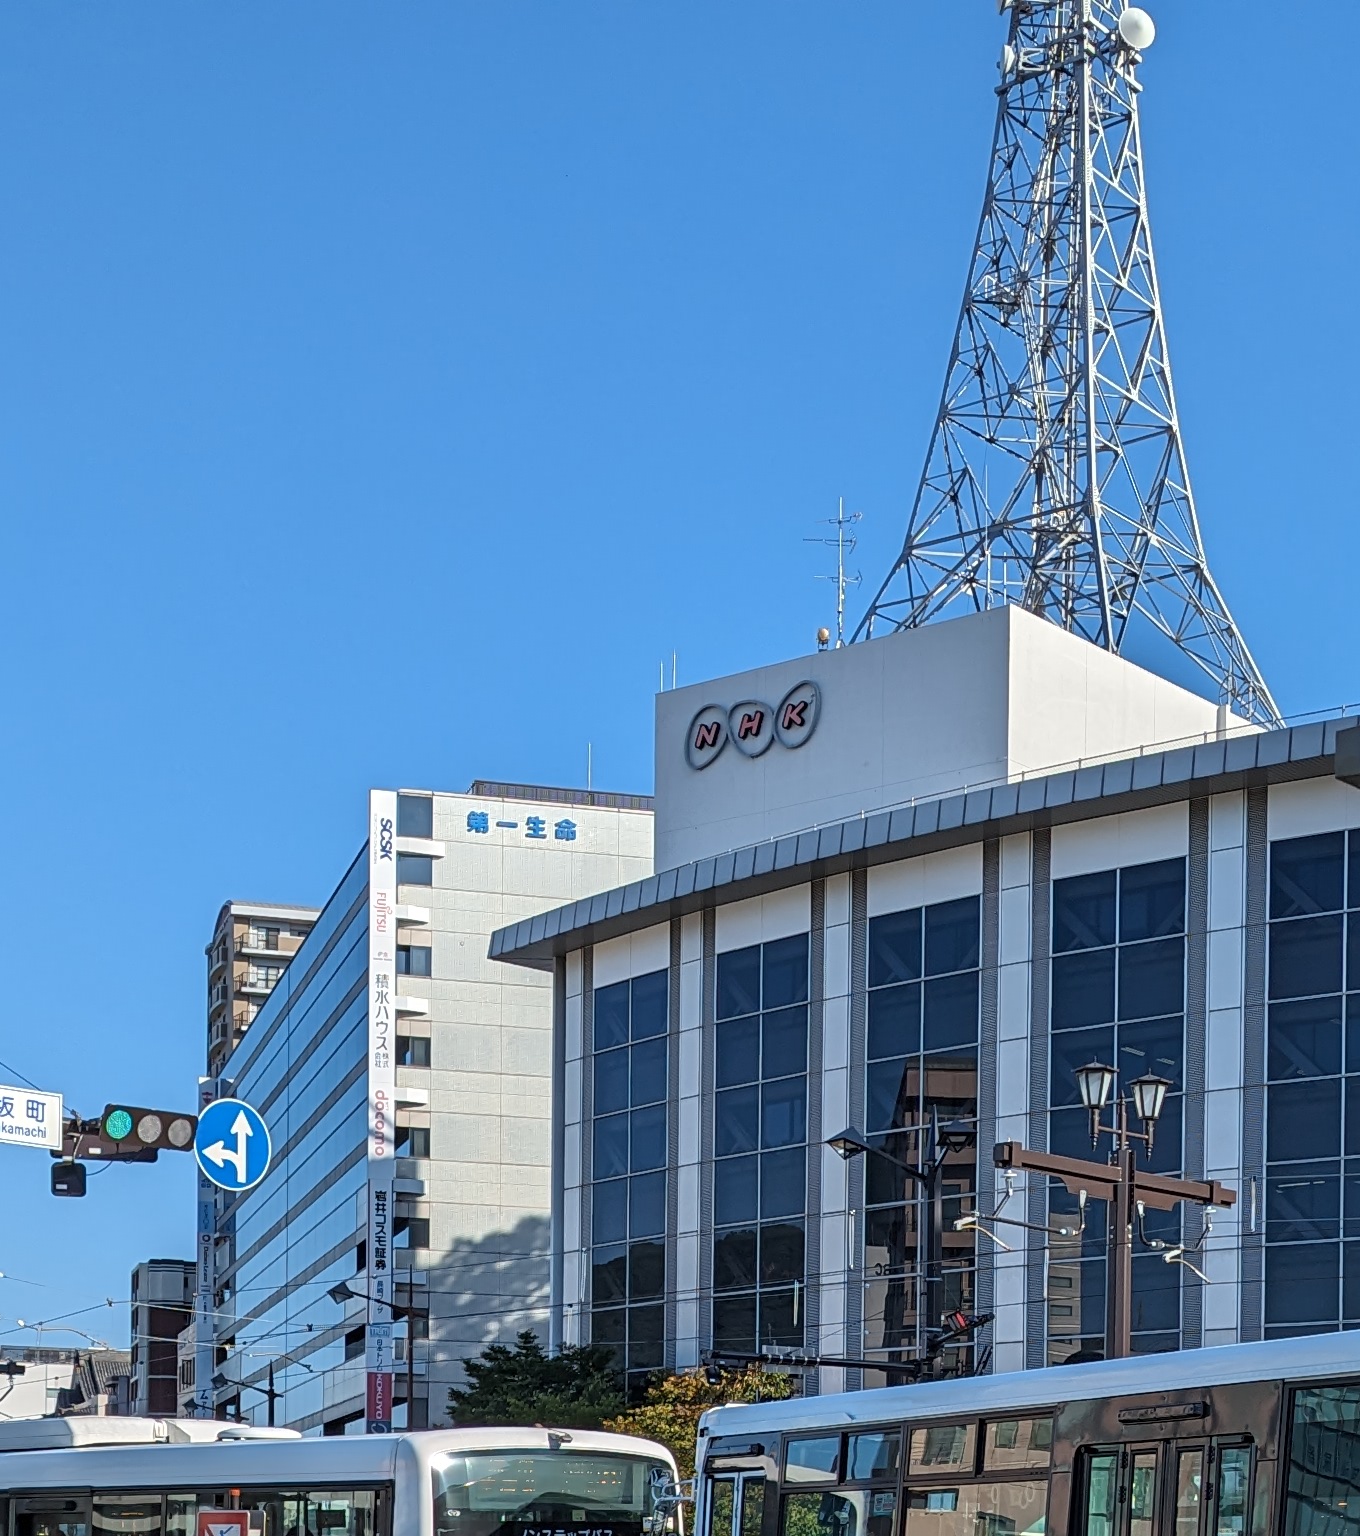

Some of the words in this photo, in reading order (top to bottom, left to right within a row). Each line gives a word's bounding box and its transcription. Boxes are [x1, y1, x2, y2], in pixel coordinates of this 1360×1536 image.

[380, 818, 393, 861] SCSK
[467, 811, 578, 842] 第一生命
[376, 892, 392, 933] FUJITSU
[375, 973, 390, 1051] 積水ハウス
[375, 1089, 389, 1156] docomo
[374, 1190, 387, 1271] 岩井コスモ証券
[375, 1373, 383, 1420] KOKUYO
